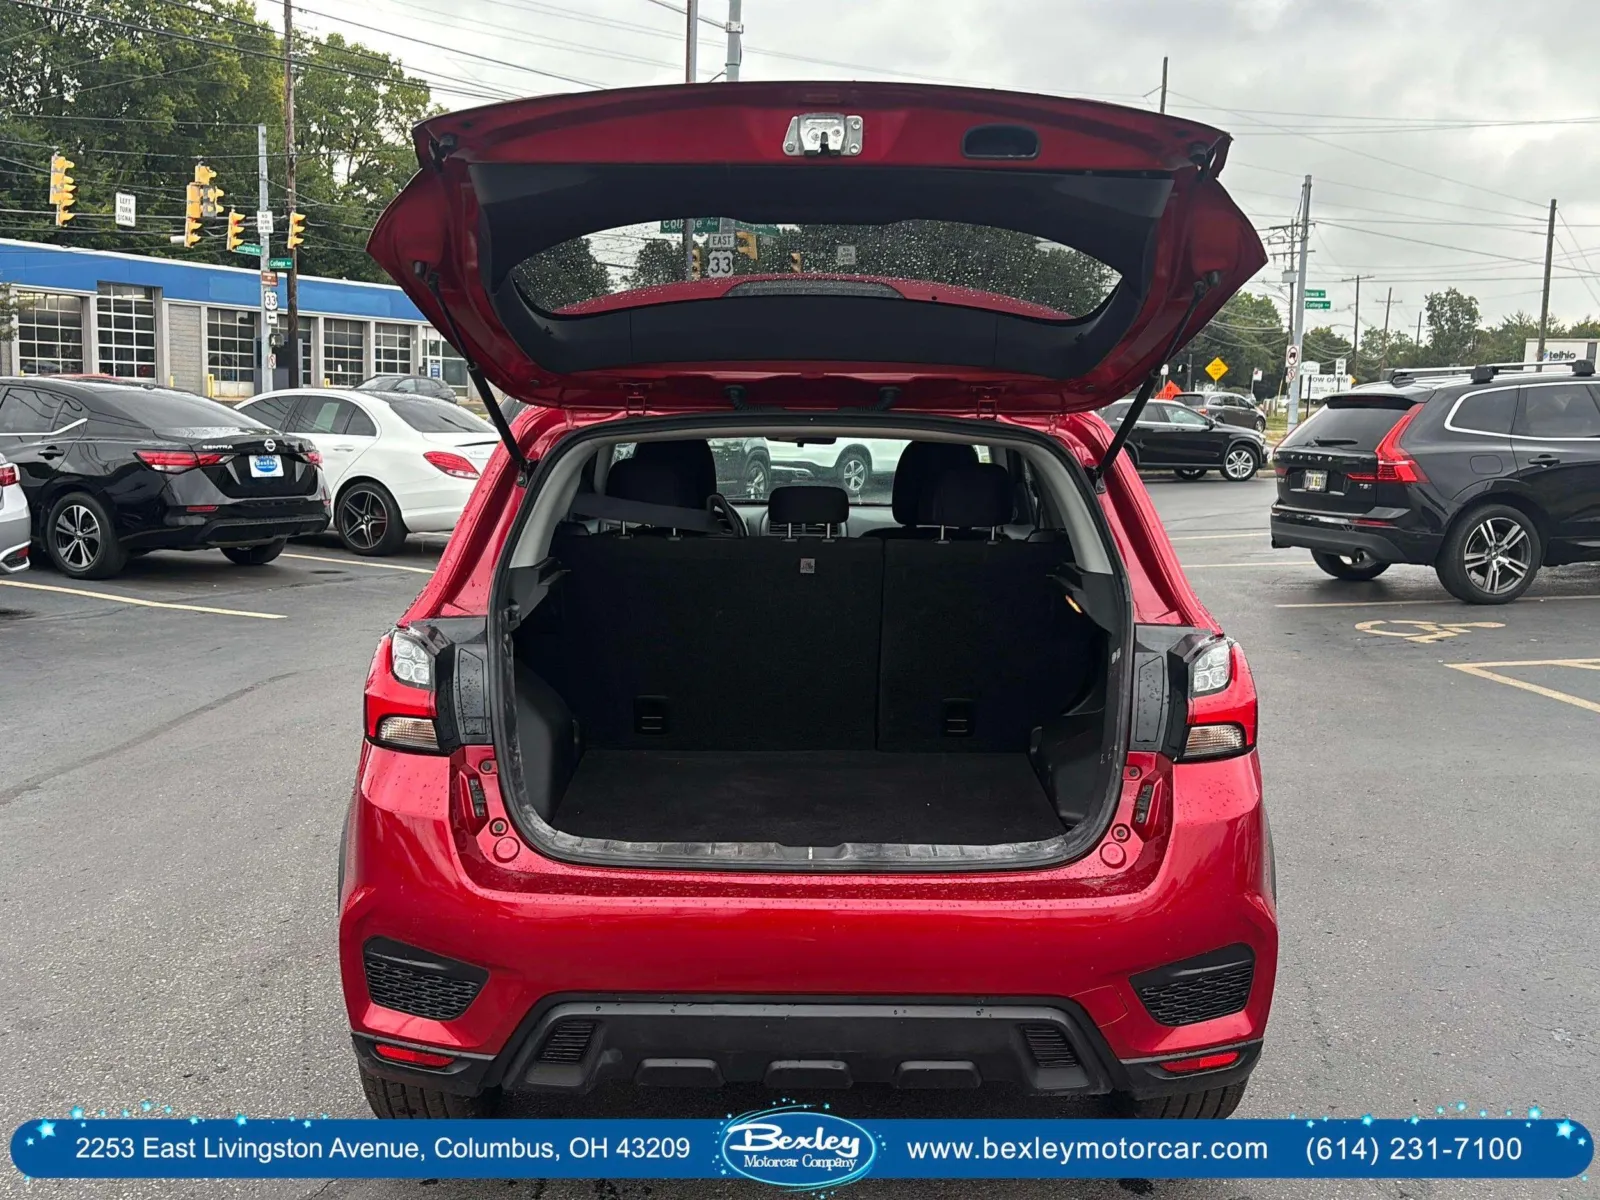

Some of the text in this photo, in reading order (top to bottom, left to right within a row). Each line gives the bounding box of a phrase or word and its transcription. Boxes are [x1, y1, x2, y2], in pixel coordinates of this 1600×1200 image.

[712, 236, 732, 246] EAST
[269, 260, 286, 268] College
[710, 256, 732, 273] 33
[266, 295, 276, 305] 33
[1549, 351, 1576, 359] telhio
